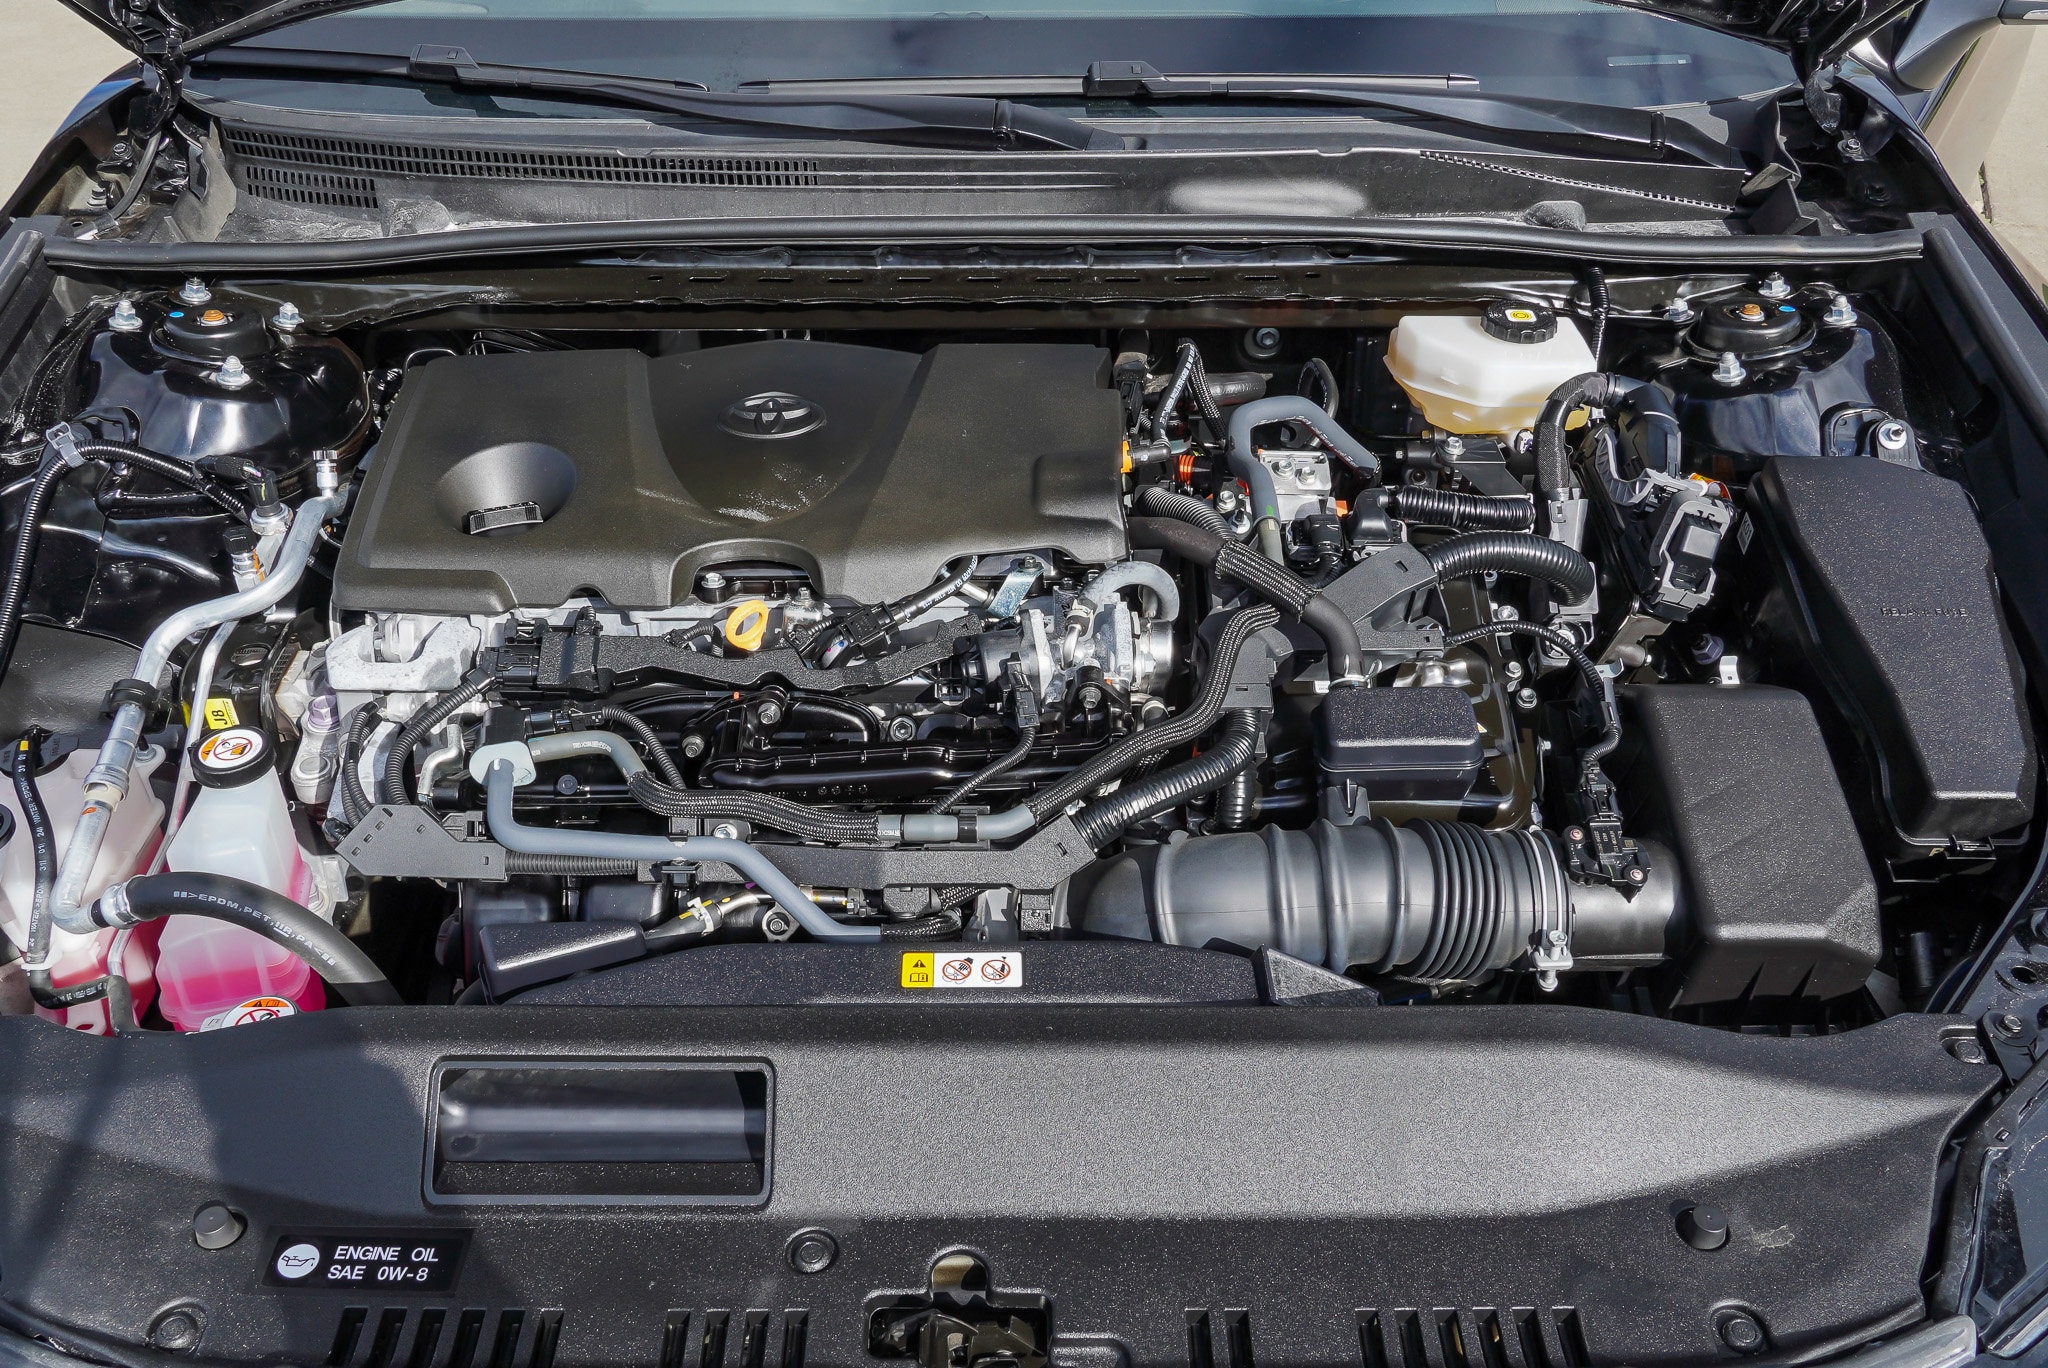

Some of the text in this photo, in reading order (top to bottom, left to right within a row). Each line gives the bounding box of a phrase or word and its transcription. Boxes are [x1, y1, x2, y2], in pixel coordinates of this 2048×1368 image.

[28, 802, 41, 825] WATER
[30, 909, 40, 933] WATER
[333, 1245, 439, 1262] ENGINE OIL
[327, 1265, 428, 1282] SAE 0W-8
